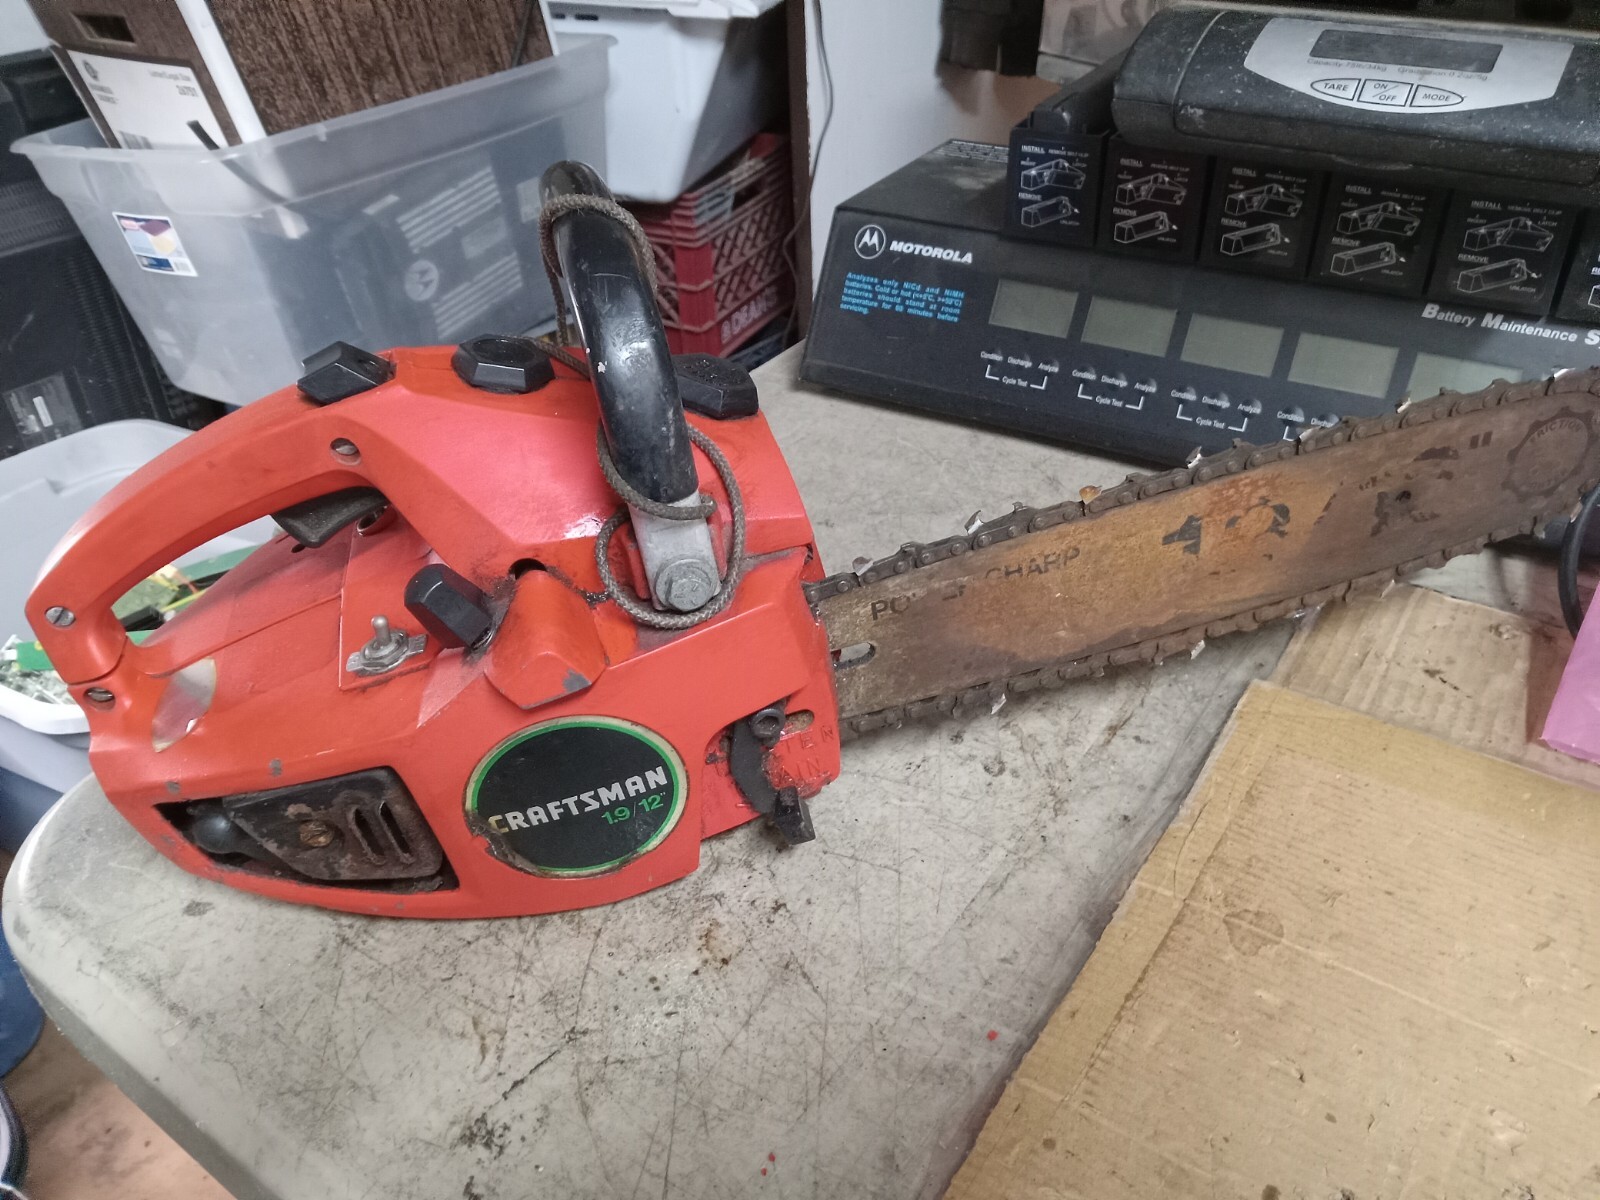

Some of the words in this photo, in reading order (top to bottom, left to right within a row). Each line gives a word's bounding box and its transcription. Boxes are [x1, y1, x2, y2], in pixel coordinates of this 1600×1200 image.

[1323, 82, 1348, 92] TARE
[1373, 82, 1388, 90] ON
[1378, 94, 1397, 102] OFF
[1422, 92, 1451, 102] MODE
[1021, 145, 1045, 154] INSTALL
[1345, 185, 1372, 195] INSTALL
[1471, 200, 1502, 210] INSTALL
[889, 240, 973, 264] MOTOROLA
[1457, 253, 1488, 264] REMOVE
[875, 285, 890, 294] Cold
[900, 289, 911, 298] hot
[883, 279, 899, 288] only
[903, 282, 921, 291] NiCd
[944, 288, 965, 298] NiMH
[843, 288, 873, 298] batteries
[877, 294, 901, 304] should
[905, 299, 925, 308] stand
[941, 306, 960, 314] room
[841, 295, 878, 307] temperature
[907, 307, 934, 317] minutes
[937, 312, 959, 322] before
[1422, 303, 1476, 327] Battery
[1480, 312, 1578, 342] Maintenance
[981, 351, 1004, 362] Condition
[1008, 356, 1032, 368] Discharge
[1038, 362, 1059, 373] Analyze
[1002, 376, 1017, 385] Cycle
[1017, 378, 1028, 387] Test
[1072, 369, 1096, 380] Condition
[1101, 375, 1128, 388] Discharge
[1134, 382, 1157, 393] Analyze
[1096, 395, 1111, 405] Cycle
[1112, 398, 1123, 407] Test
[1171, 389, 1197, 401] Condition
[1201, 396, 1230, 409] Discharge
[1238, 403, 1261, 414] Analyze
[1277, 410, 1304, 422] Condition
[1196, 416, 1212, 426] Cycle
[1213, 420, 1225, 429] Test
[488, 766, 668, 834] CRAFTSMAN
